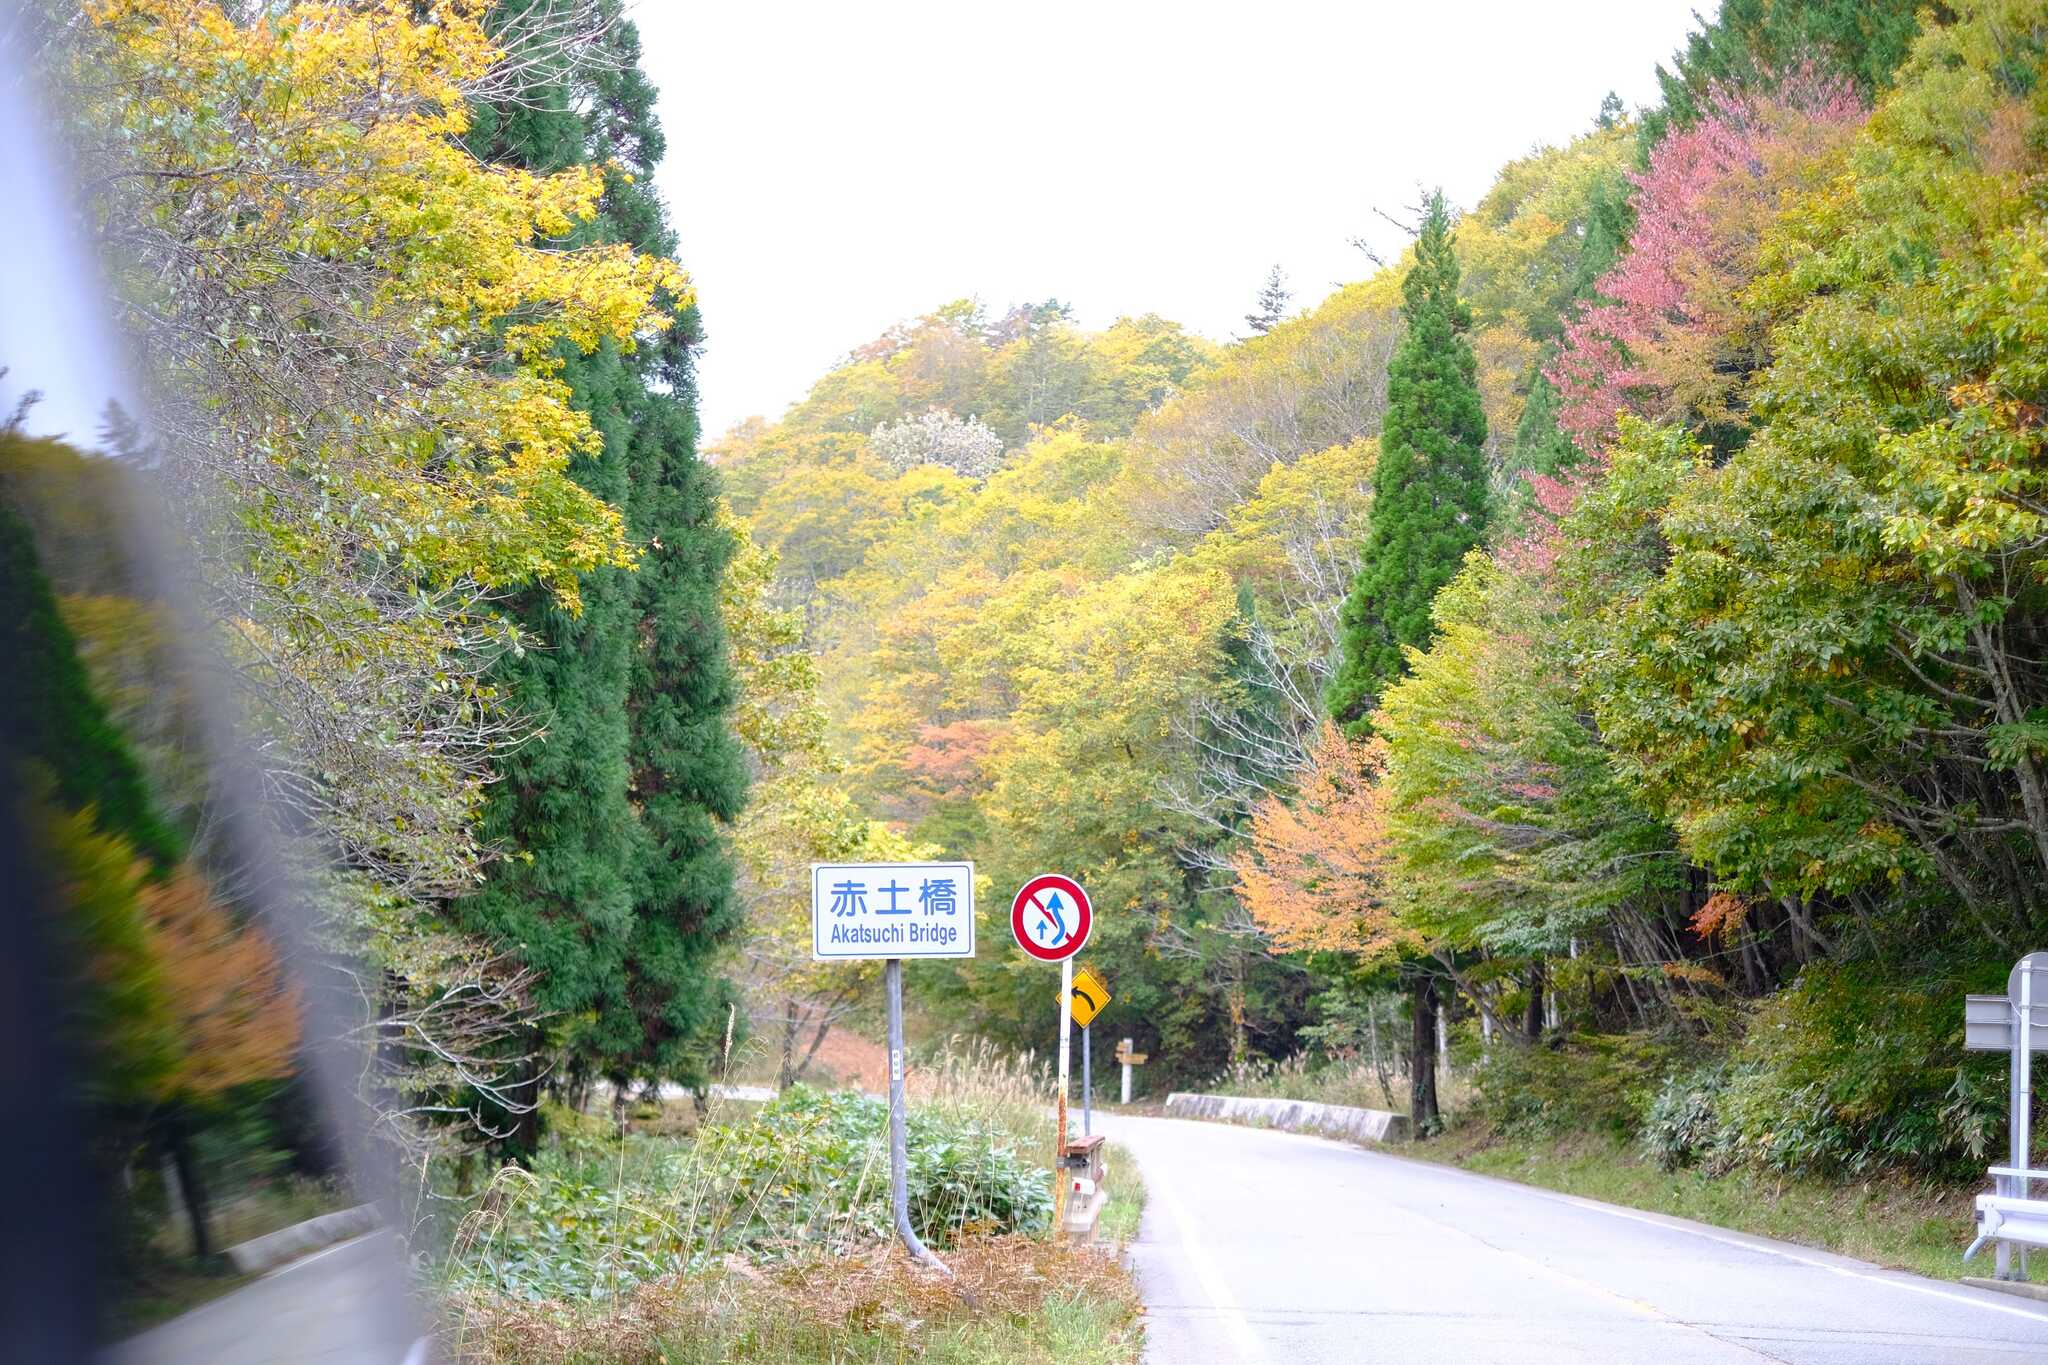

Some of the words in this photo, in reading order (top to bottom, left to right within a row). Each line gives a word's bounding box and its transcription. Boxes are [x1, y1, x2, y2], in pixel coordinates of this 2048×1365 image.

[830, 878, 957, 917] 赤土橋
[831, 923, 904, 943] Akatsuchi
[909, 922, 957, 945] Bridge
